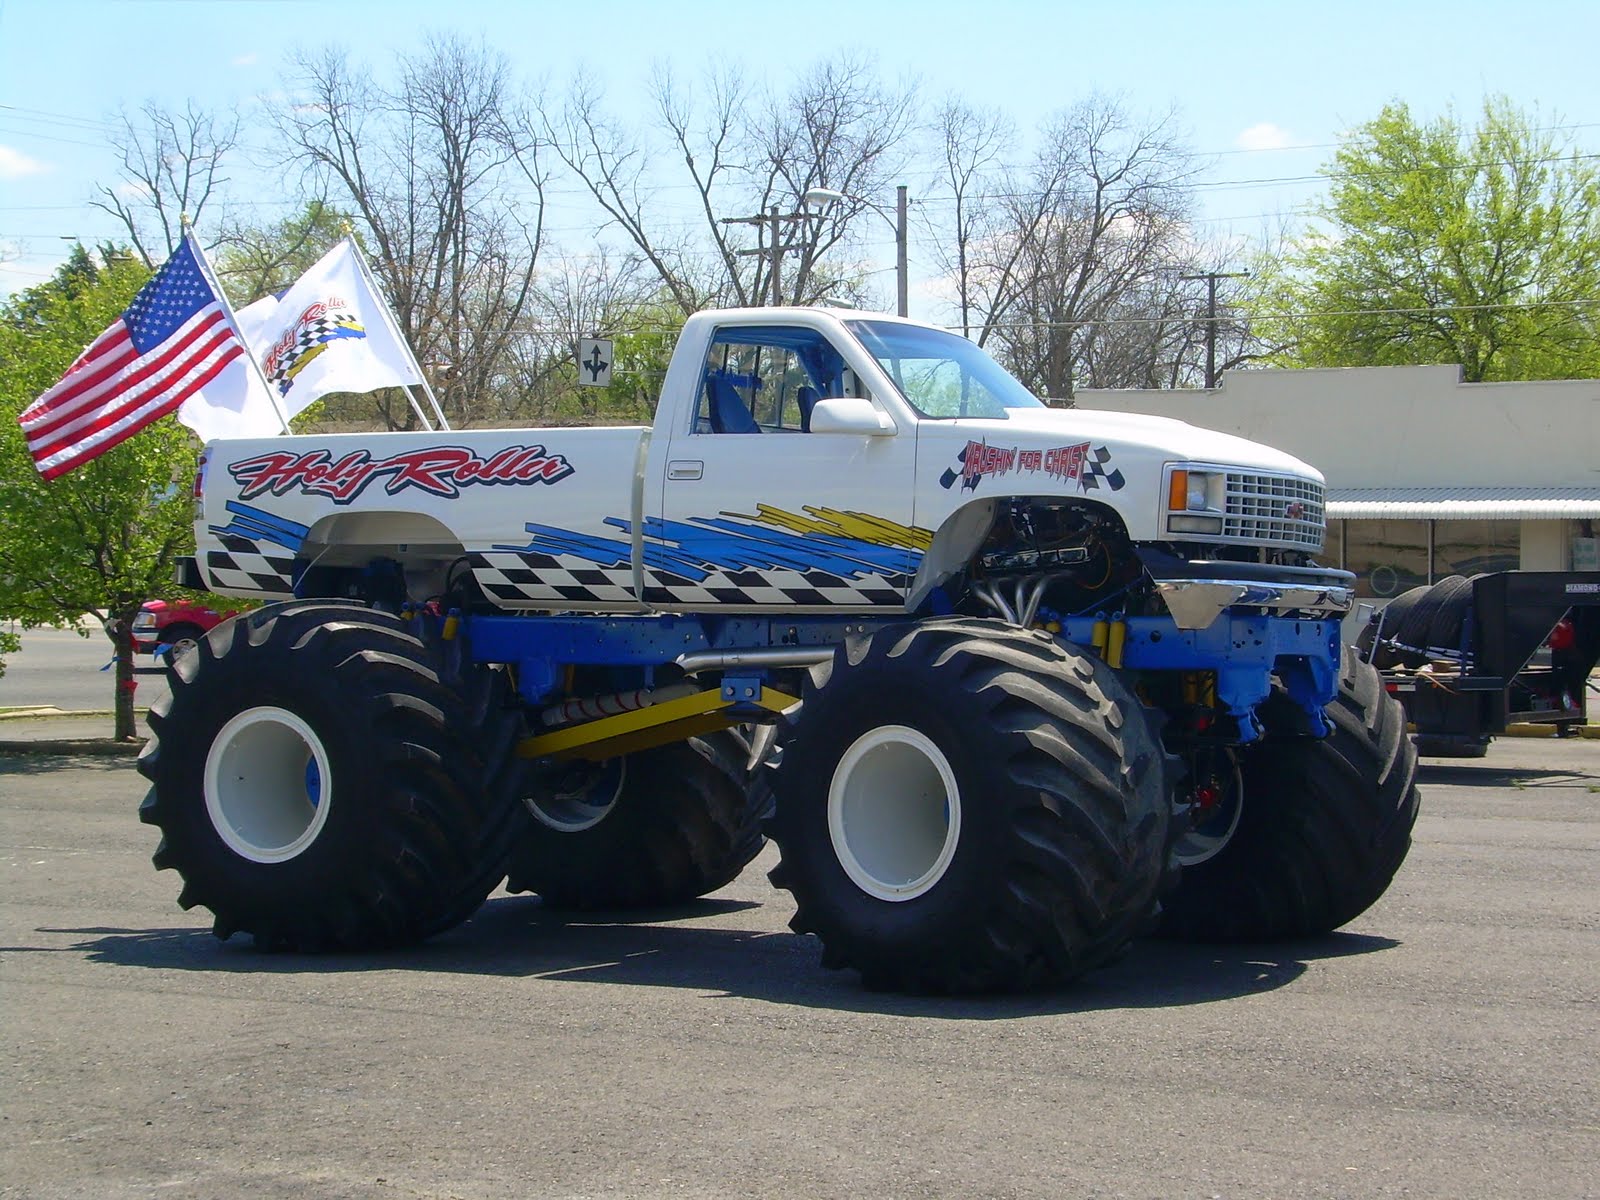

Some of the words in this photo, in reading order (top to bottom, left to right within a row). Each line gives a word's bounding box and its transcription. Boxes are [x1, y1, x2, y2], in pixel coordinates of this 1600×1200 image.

[262, 328, 298, 376] Holy
[227, 449, 382, 505] Holy
[382, 445, 575, 499] Roller
[1017, 450, 1043, 474] FOR
[1044, 441, 1091, 490] CHRIST
